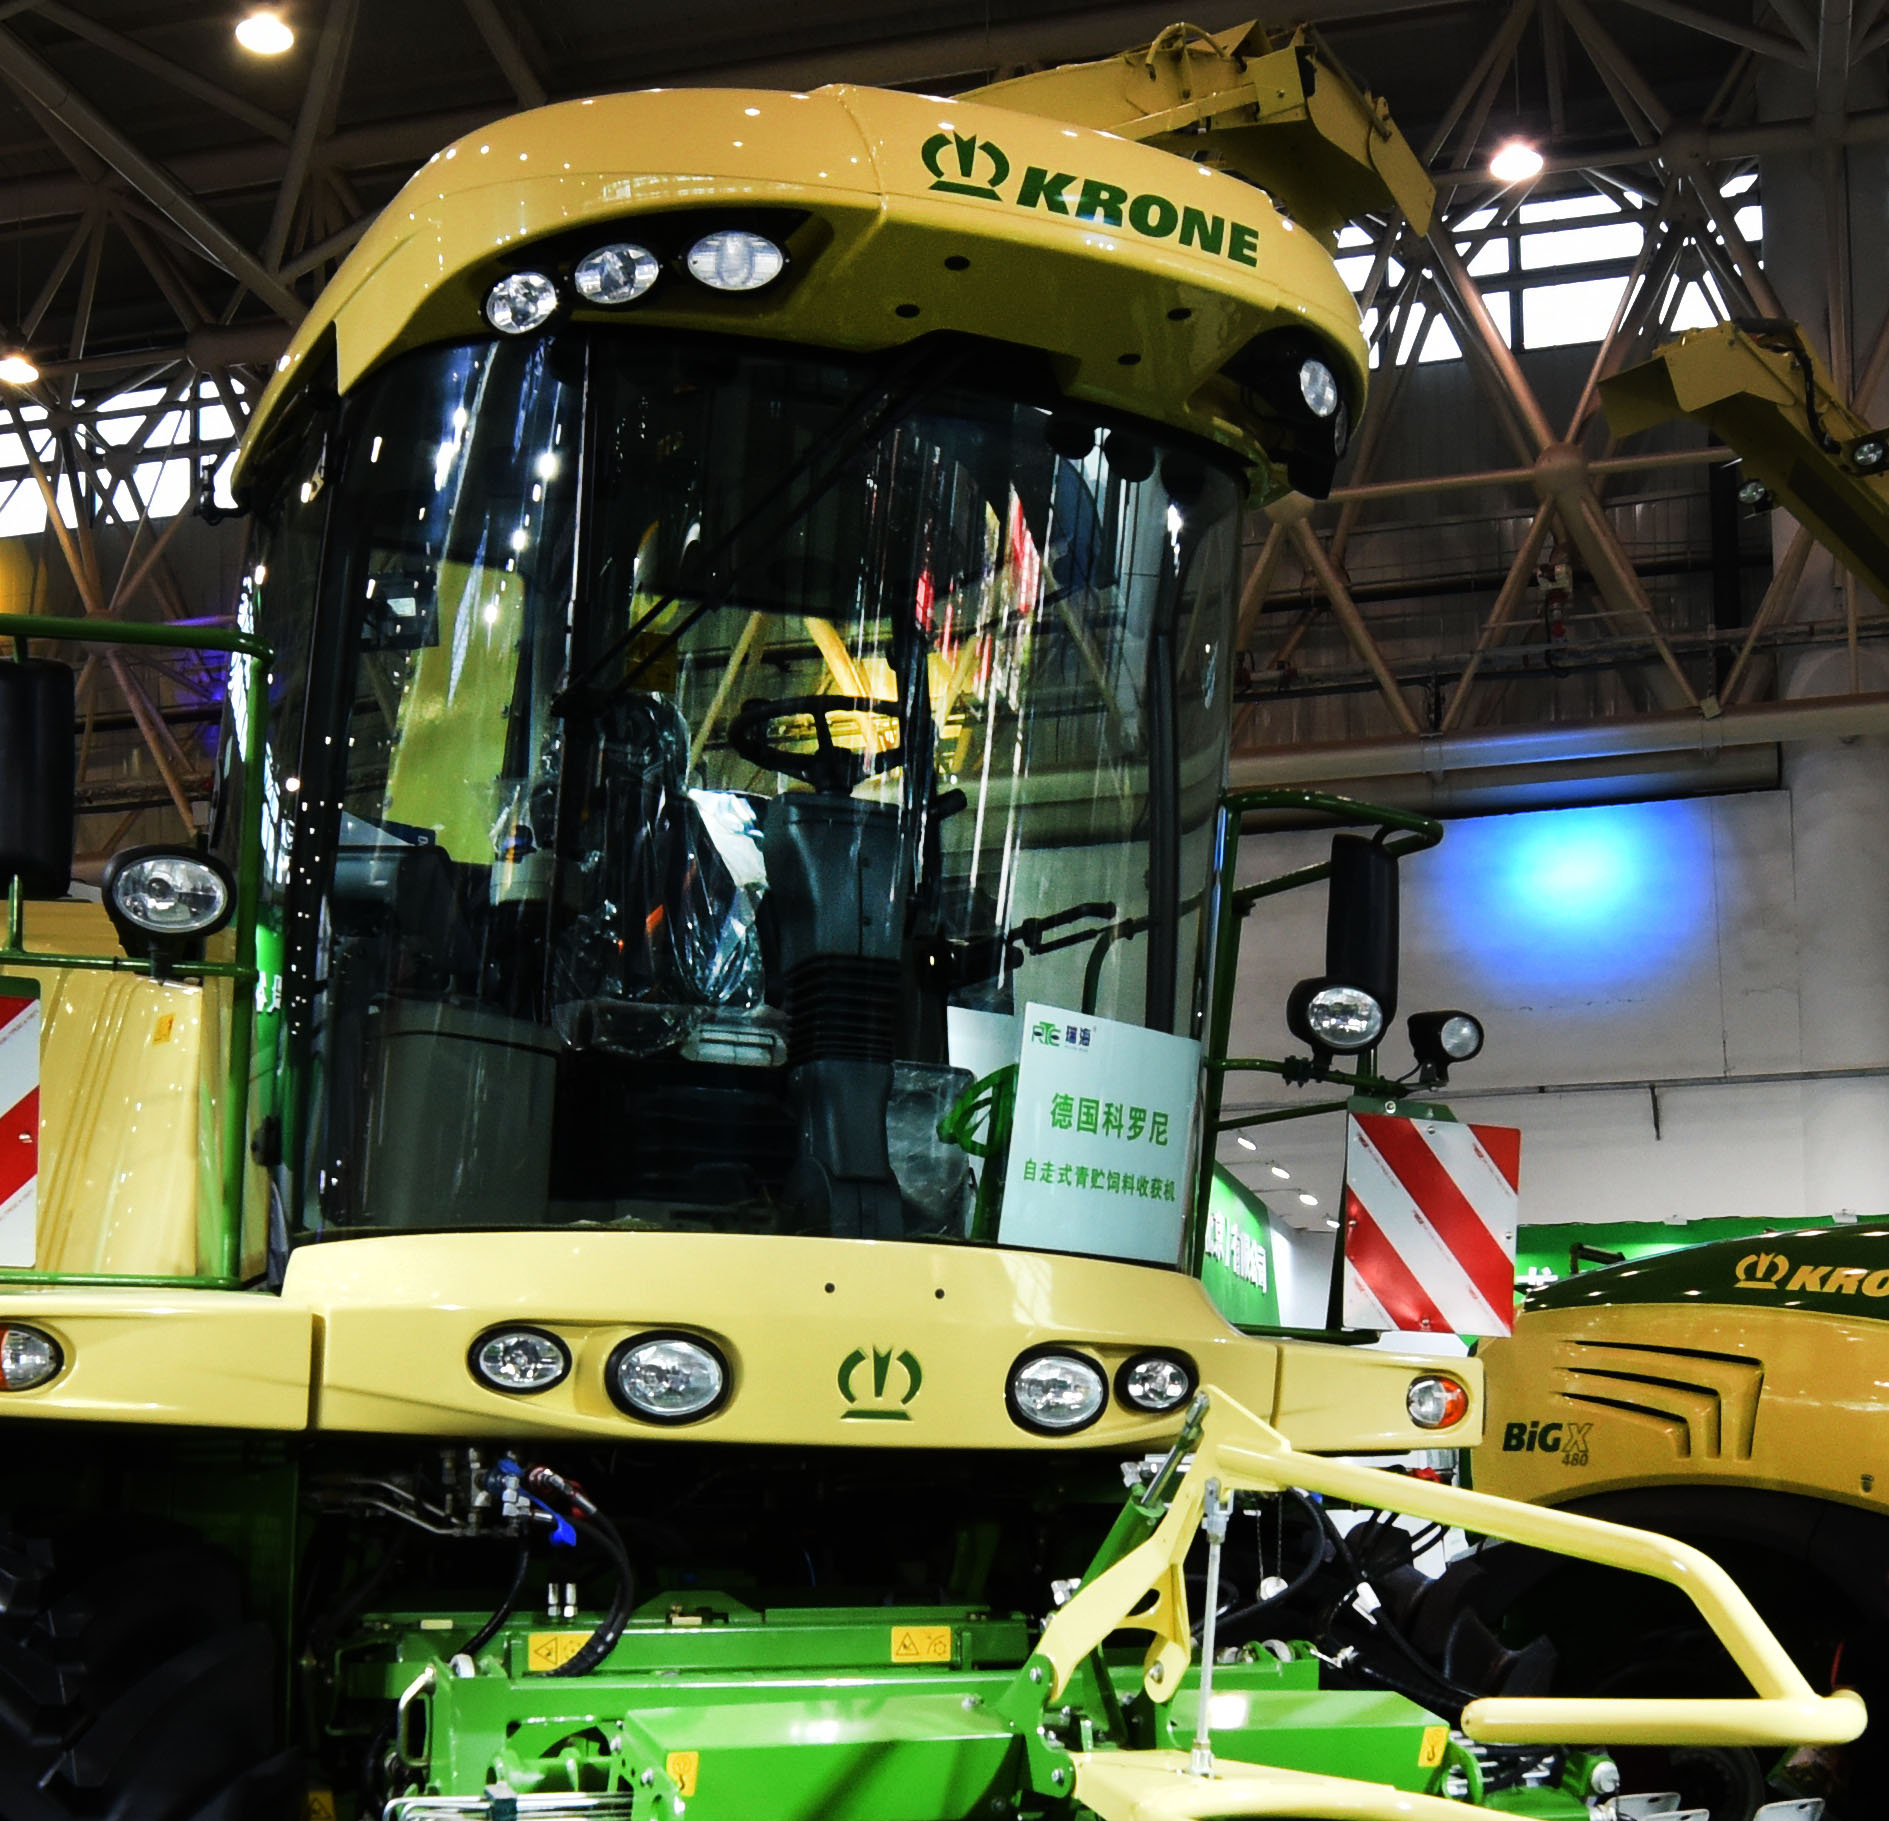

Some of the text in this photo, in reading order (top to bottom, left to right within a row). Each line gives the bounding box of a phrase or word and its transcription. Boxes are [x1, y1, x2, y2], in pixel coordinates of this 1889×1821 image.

[1016, 166, 1259, 267] KRONE
[1050, 1092, 1169, 1146] 德国科罗尼
[1023, 1157, 1177, 1202] 自走式青贮饲料收获机
